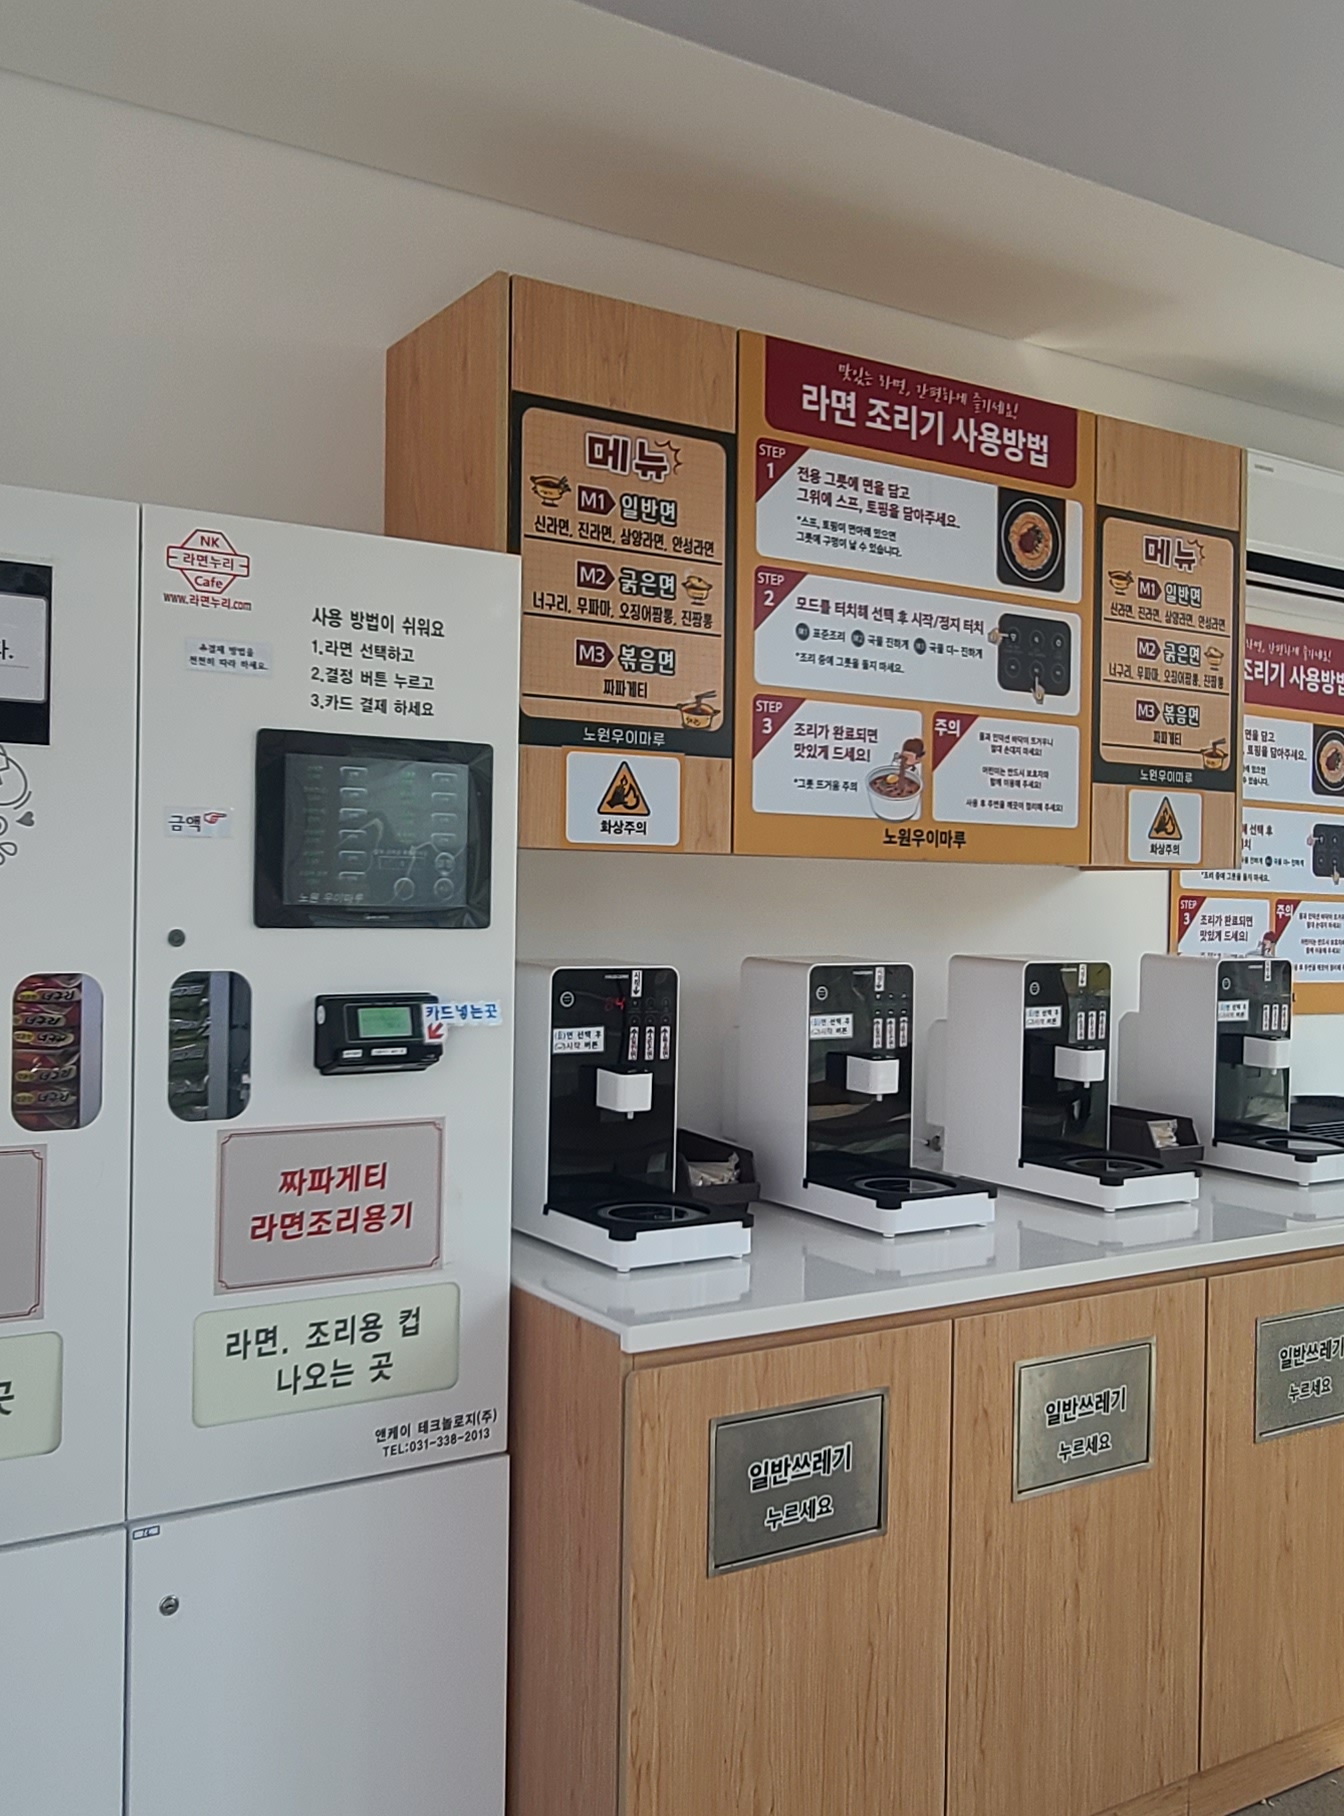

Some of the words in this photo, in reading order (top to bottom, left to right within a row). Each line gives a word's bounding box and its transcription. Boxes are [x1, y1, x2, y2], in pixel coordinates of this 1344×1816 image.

[801, 383, 856, 428] 라면
[864, 397, 945, 447] 조리기
[951, 418, 1049, 468] 사용방법
[586, 434, 670, 482] 메뉴
[759, 444, 786, 459] STEP
[766, 463, 774, 479] 1
[797, 466, 821, 485] 전용
[824, 471, 859, 492] 그릇에
[862, 478, 885, 496] 면을
[888, 483, 910, 500] 담고
[580, 490, 605, 511] M1
[621, 494, 677, 526] 일반면
[797, 488, 832, 508] 그위에
[836, 494, 862, 514] 스프,
[866, 500, 899, 520] 토핑을
[903, 505, 961, 529] 담아주세요.
[200, 535, 220, 549] NK
[534, 515, 573, 537] 신라면,
[578, 521, 615, 544] 진라면,
[620, 527, 667, 552] 삼양라면,
[672, 536, 714, 558] 안성라면
[183, 551, 235, 572] 라면누리
[1145, 537, 1196, 572] 메뉴
[194, 576, 223, 590] Cafe
[579, 567, 606, 586] M2
[619, 568, 676, 599] 굵은면
[757, 571, 785, 586] STEP
[163, 592, 252, 612] www.라면누리.com
[533, 591, 571, 614] 너구리,
[576, 597, 614, 619] 무파마,
[763, 590, 774, 607] 2
[1140, 581, 1156, 597] M1
[1164, 582, 1202, 608] 일반면
[312, 607, 343, 628] 사용
[350, 610, 395, 634] 방법이
[401, 616, 445, 638] 쉬워요
[795, 597, 831, 615] 모드를
[834, 603, 868, 621] 터치해
[871, 607, 895, 623] 선택
[897, 610, 908, 625] 후
[911, 612, 960, 632] 시작/정지
[962, 619, 984, 635] 터치
[360, 643, 414, 663] 선택하고
[579, 645, 605, 663] M3
[619, 645, 675, 675] 볶음면
[1138, 641, 1156, 657] M2
[1163, 641, 1201, 668] 굵은면
[360, 670, 388, 688] 버튼
[394, 672, 435, 691] 누르고
[360, 697, 387, 715] 결제
[394, 698, 434, 717] 하세요
[755, 700, 783, 714] STEP
[1138, 703, 1155, 718] M3
[1163, 702, 1200, 727] 볶음면
[583, 727, 666, 746] 노원우이마루
[762, 718, 772, 734] 3
[793, 722, 830, 741] 조리가
[832, 725, 878, 743] 완료되면
[935, 718, 960, 738] 주의
[793, 743, 829, 761] 맛있게
[832, 746, 871, 763] 드세요!
[1140, 769, 1193, 784] 노원우이마루
[168, 814, 201, 833] 금액
[600, 820, 647, 836] 화상주의
[883, 827, 966, 849] 노원우이마루
[1150, 843, 1180, 856] 화상주의
[1180, 900, 1197, 910] STEP
[1276, 904, 1294, 919] 주의
[1183, 913, 1191, 925] 3
[1200, 914, 1222, 927] 조리가
[1224, 915, 1253, 928] 완료되면
[1199, 930, 1222, 942] 맛있게
[278, 1162, 387, 1196] 짜파게티
[250, 1201, 413, 1243] 라면조리용기
[225, 1326, 288, 1361] 라면.
[305, 1312, 383, 1350] 조리용
[398, 1306, 421, 1338] 컵
[276, 1359, 354, 1396] 나오는
[369, 1352, 393, 1384] 곳
[1288, 1377, 1332, 1402] 누르세요
[1045, 1386, 1127, 1427] 일반쓰레기
[375, 1423, 411, 1444] 앤케이
[418, 1408, 497, 1437] 테크놀로지(주)
[382, 1427, 490, 1457] TEL:031-338-2013
[1058, 1433, 1112, 1462] 누르세요
[750, 1443, 852, 1491] 일반쓰레기
[765, 1496, 834, 1530] 누르세요
